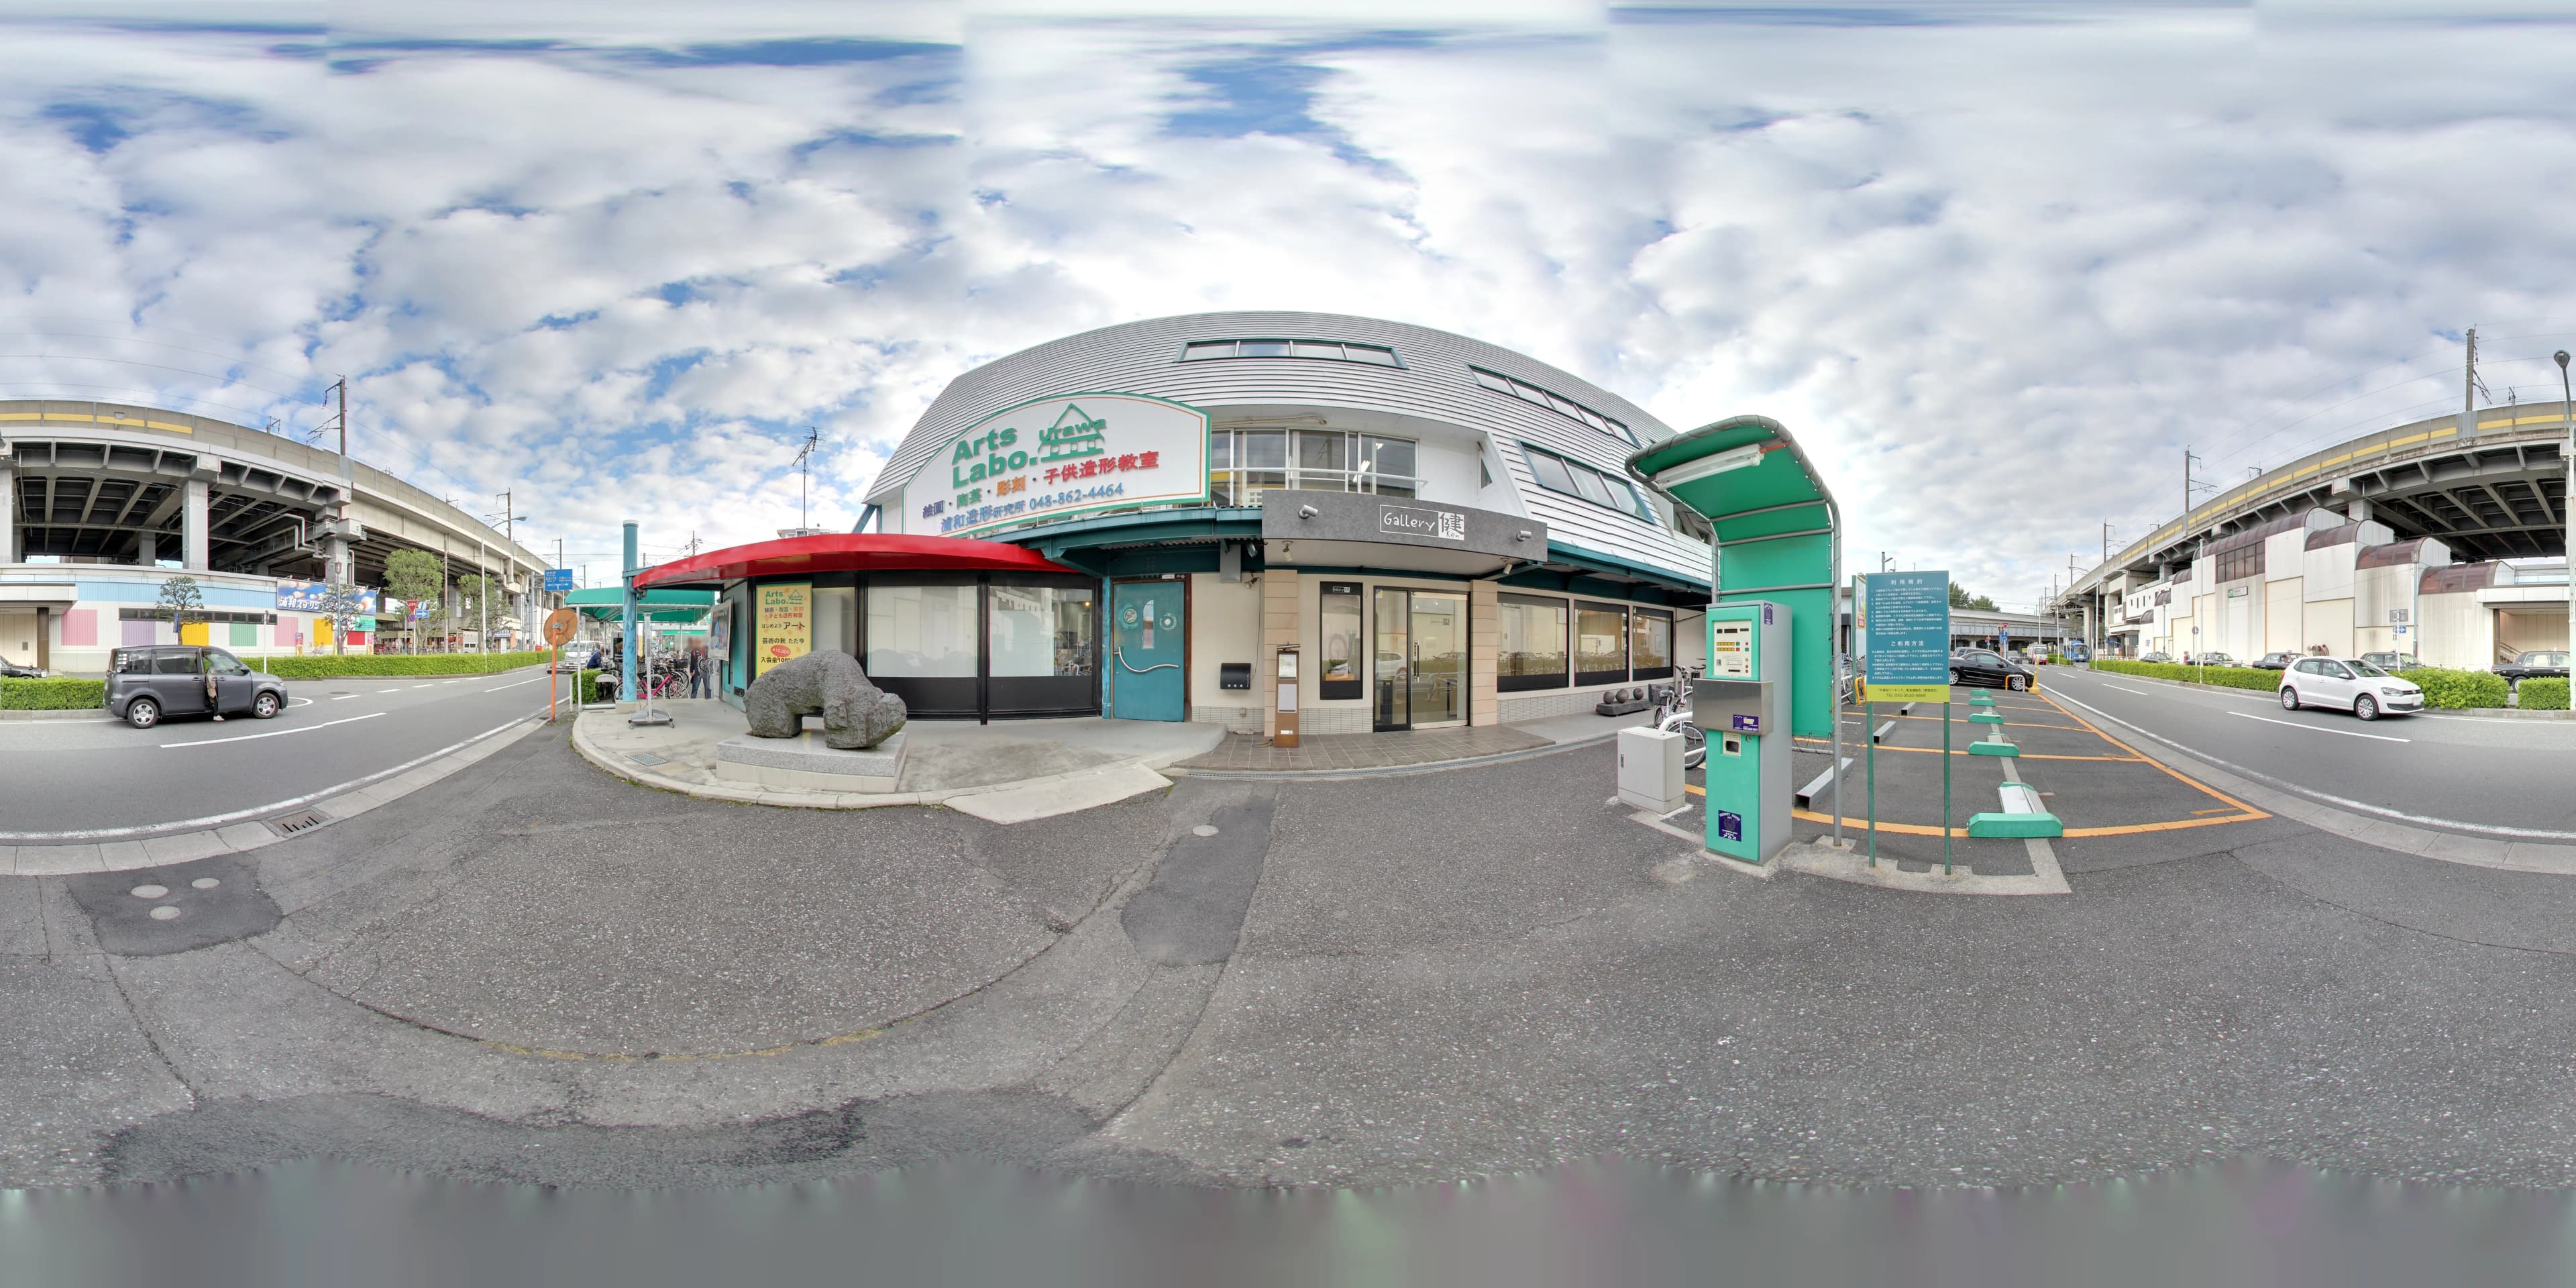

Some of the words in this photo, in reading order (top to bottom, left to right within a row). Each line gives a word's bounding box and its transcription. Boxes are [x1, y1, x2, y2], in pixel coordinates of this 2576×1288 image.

[1039, 419, 1106, 441] Urawa
[952, 427, 1017, 465] Arts
[953, 451, 1038, 488] Labo.
[941, 500, 1025, 533] 浦和造形研究所
[1029, 482, 1124, 510] 048-862-4464
[1384, 513, 1436, 531] Gallery
[765, 597, 788, 605] Labo.
[784, 622, 806, 630] アート
